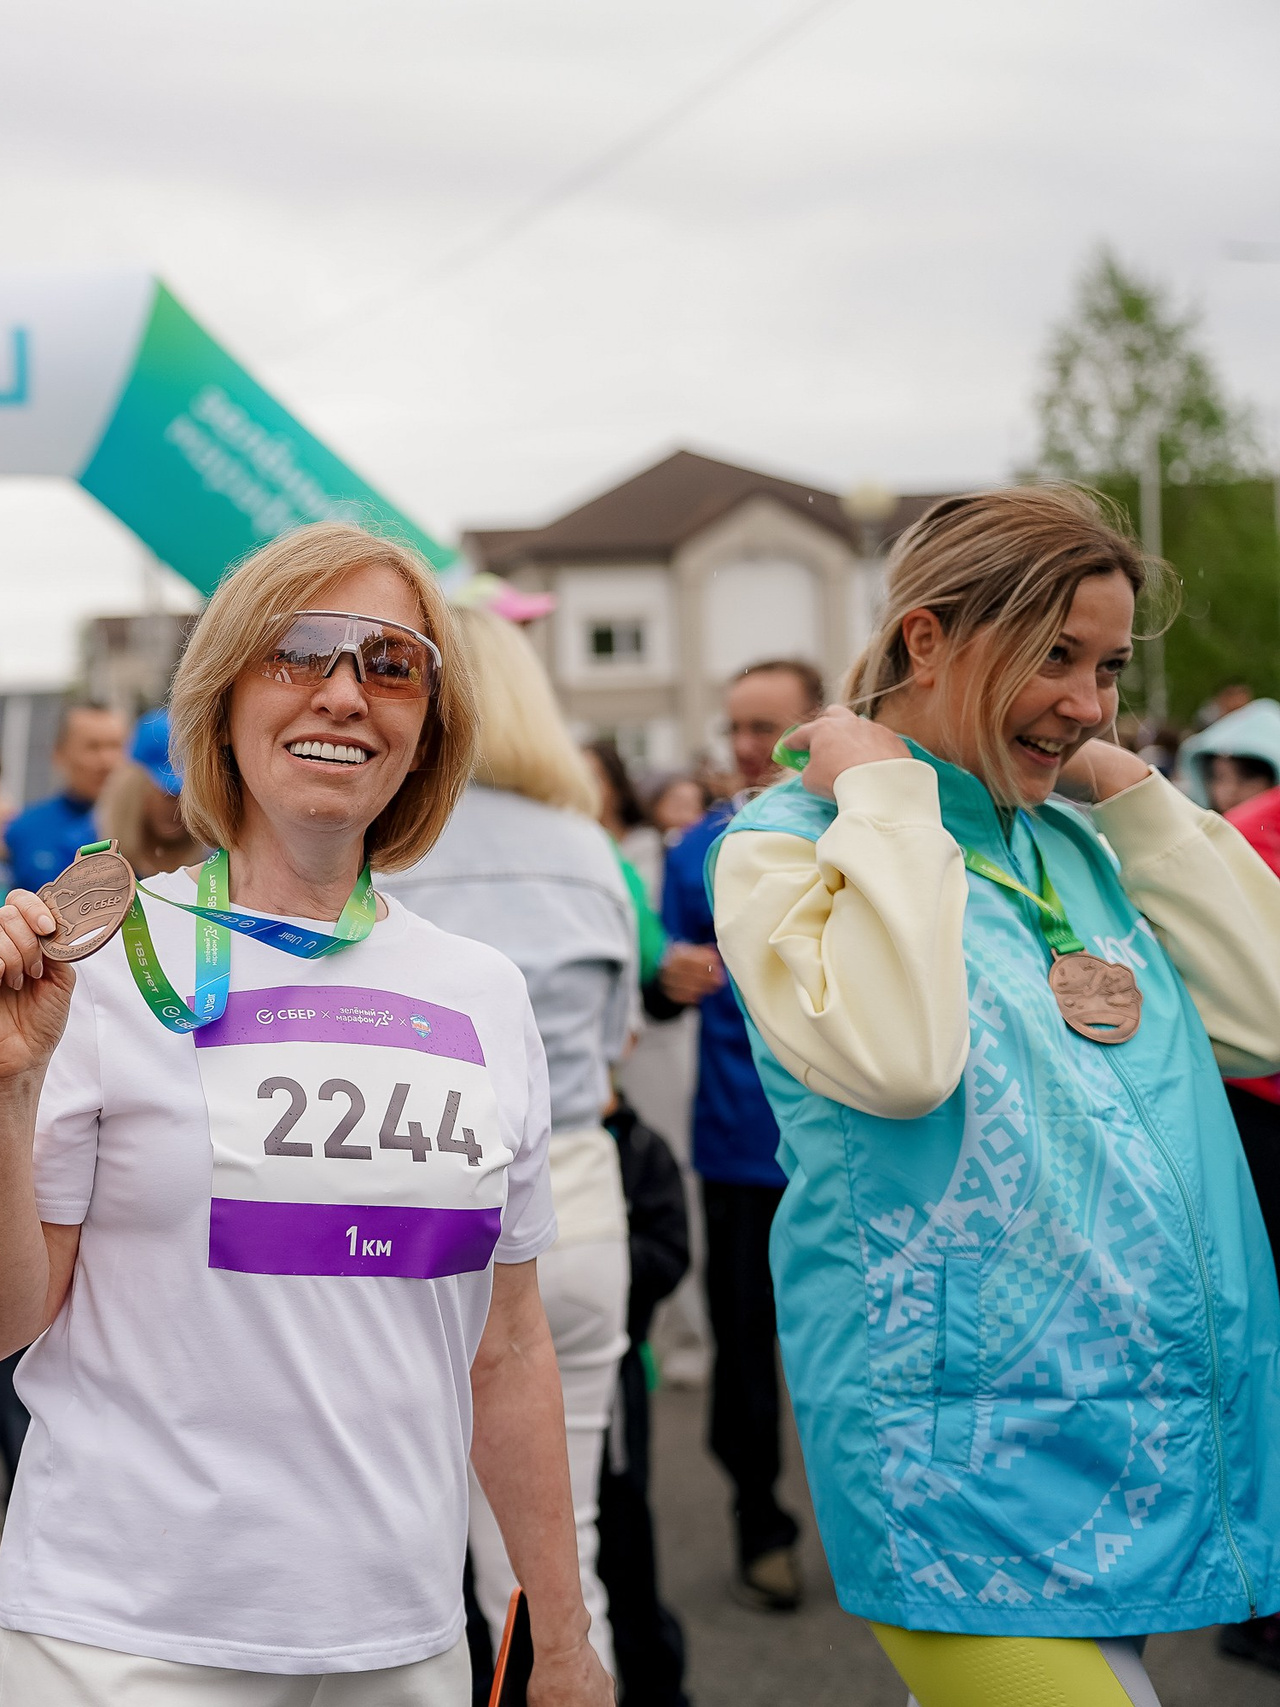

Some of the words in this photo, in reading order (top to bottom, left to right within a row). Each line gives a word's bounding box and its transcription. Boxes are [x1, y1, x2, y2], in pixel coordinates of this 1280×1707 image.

[209, 874, 217, 893] лет
[94, 896, 122, 911] СБЕР
[208, 895, 217, 910] 85
[134, 941, 148, 967] 185
[143, 970, 159, 993] лет
[276, 1009, 317, 1020] СБЕР
[335, 1014, 374, 1025] марафон
[339, 1007, 376, 1017] зелёный
[257, 1076, 483, 1167] 2244
